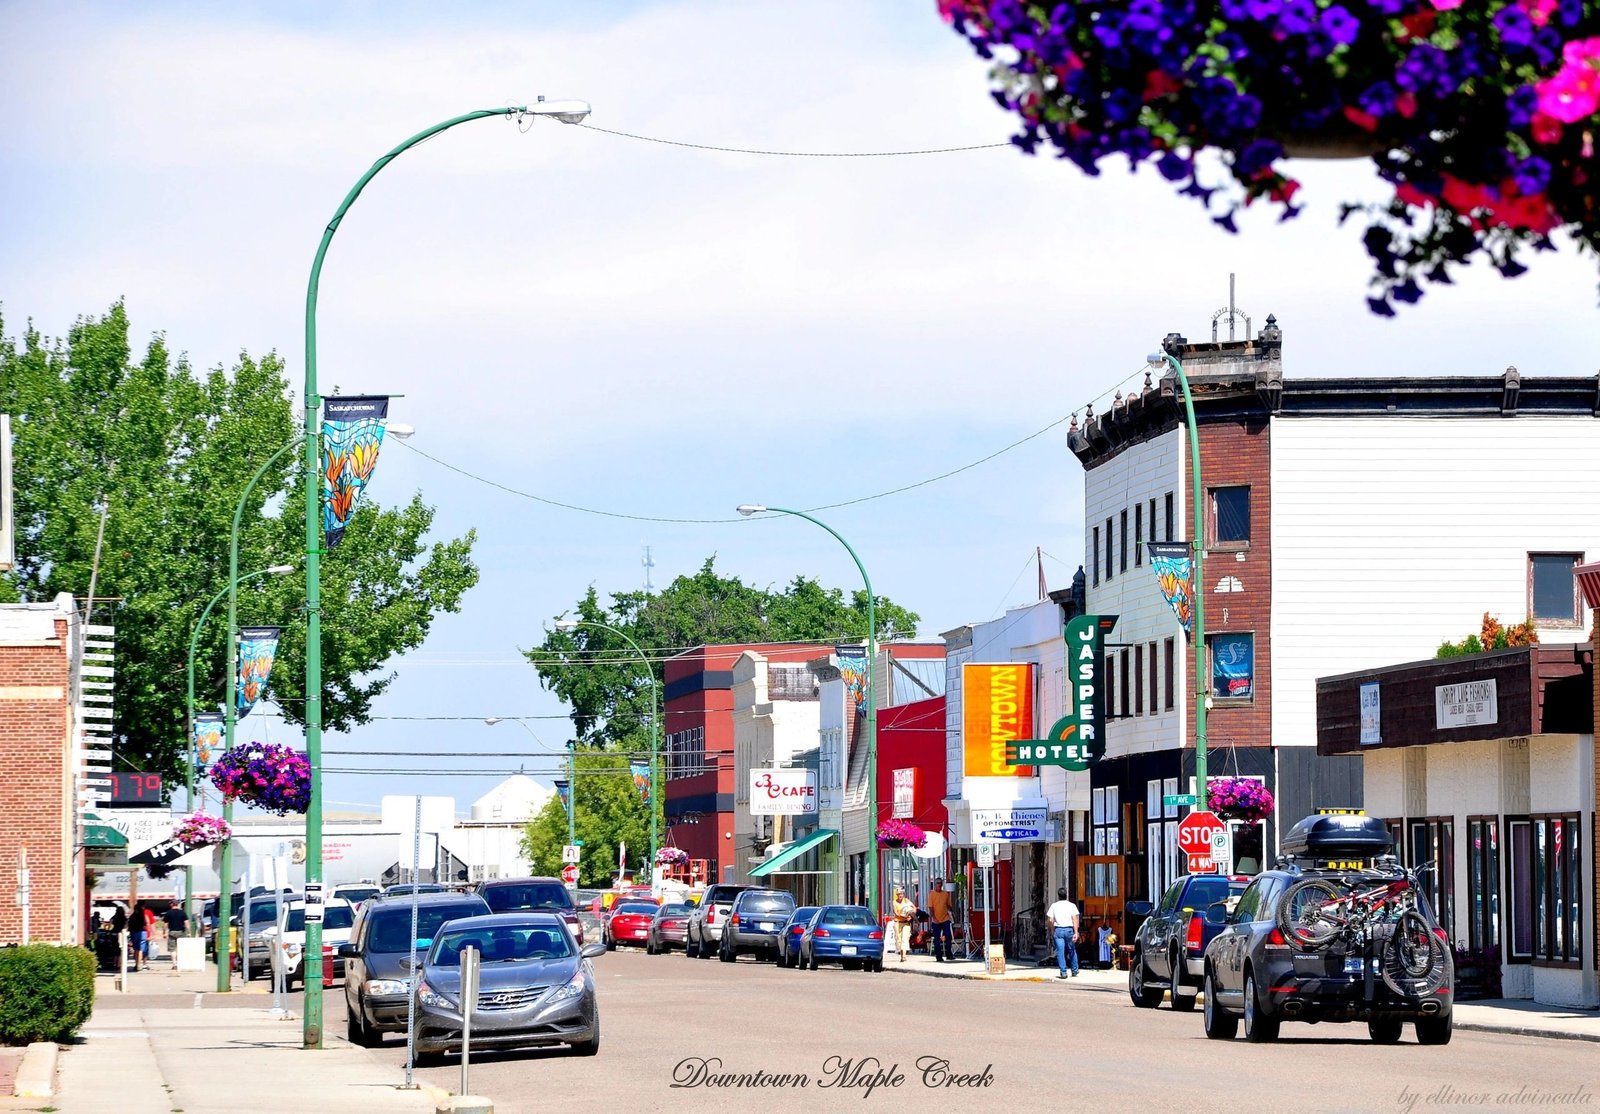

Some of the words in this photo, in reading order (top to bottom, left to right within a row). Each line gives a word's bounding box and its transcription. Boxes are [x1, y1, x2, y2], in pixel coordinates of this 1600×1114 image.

[1078, 625, 1096, 740] JASPER
[990, 666, 1018, 775] COWTOWN
[1019, 745, 1094, 759] HOTEL
[782, 786, 815, 797] CAFE
[982, 819, 1036, 827] OPTOMETRIST
[1004, 829, 1034, 838] OPTICAL
[1189, 858, 1197, 869] 4
